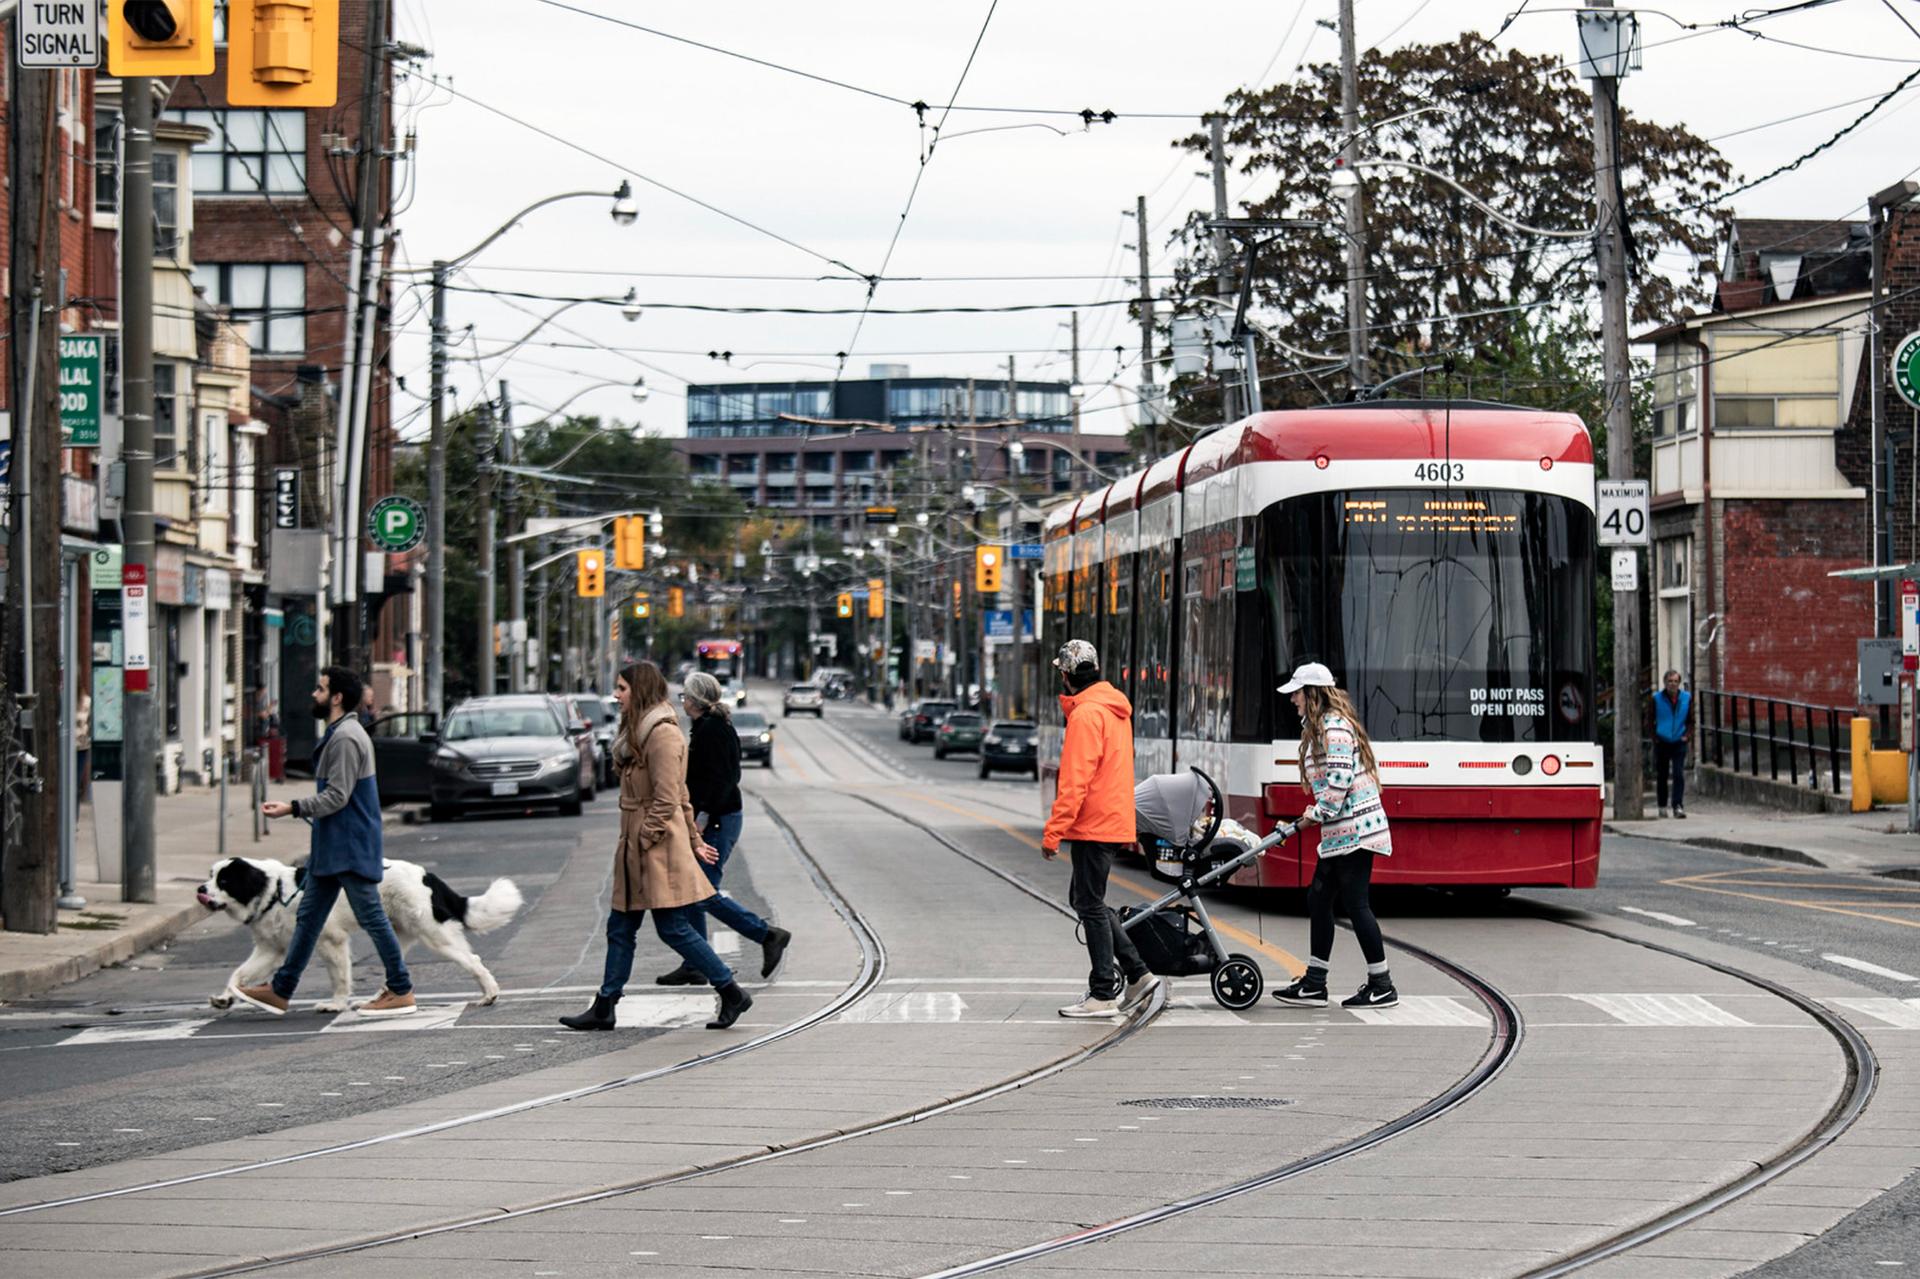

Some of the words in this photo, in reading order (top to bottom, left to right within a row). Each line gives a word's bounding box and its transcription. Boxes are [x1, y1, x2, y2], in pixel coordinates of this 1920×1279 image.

[33, 3, 84, 25] TURN
[25, 33, 94, 55] SIGNAL
[1414, 462, 1464, 481] 4603
[1601, 489, 1645, 498] MAXIMUM
[386, 510, 409, 533] P
[1602, 508, 1645, 535] 40
[1470, 688, 1487, 701] DO
[1490, 688, 1513, 701] NOT
[1516, 688, 1545, 701] PASS
[1471, 703, 1503, 716] OPEN
[1507, 703, 1545, 716] DOORS
